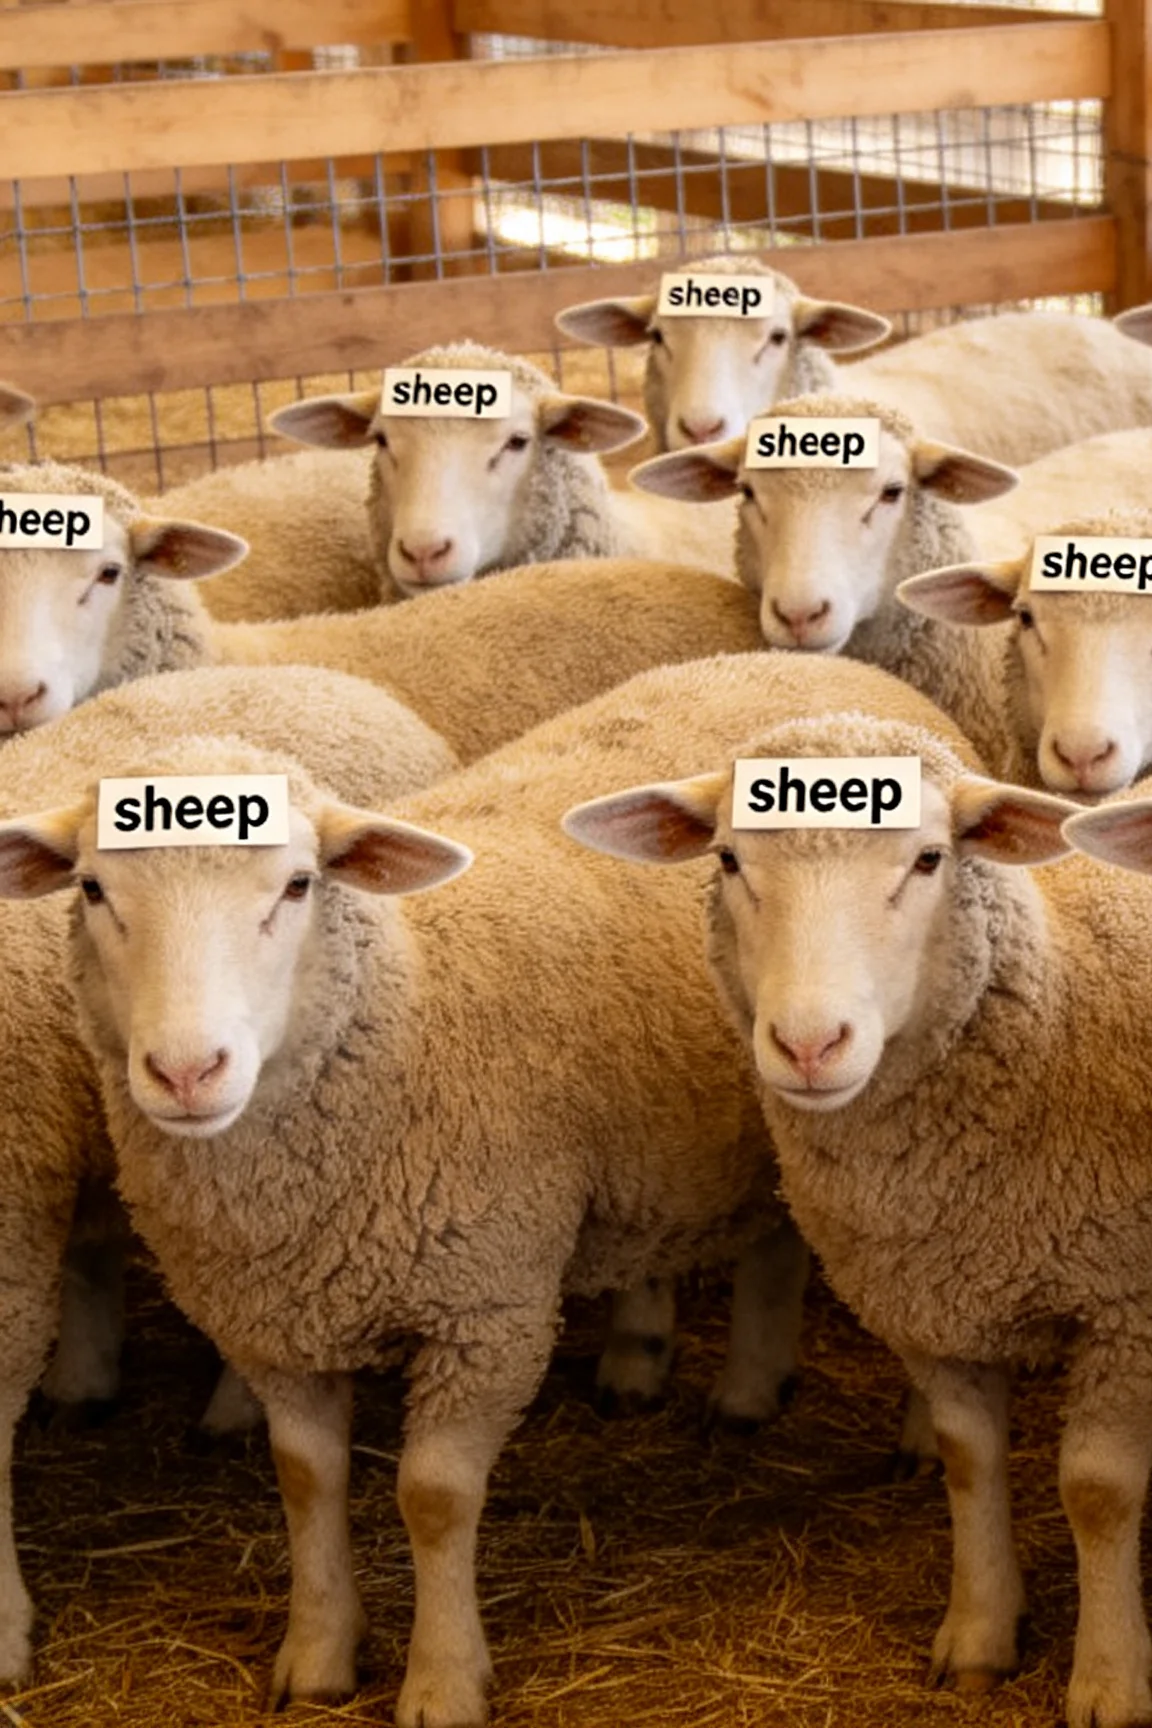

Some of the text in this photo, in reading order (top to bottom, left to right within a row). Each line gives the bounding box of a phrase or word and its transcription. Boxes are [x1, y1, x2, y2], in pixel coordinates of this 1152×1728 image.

[669, 279, 762, 316] sheep
[393, 373, 498, 415] sheep
[757, 423, 865, 465] sheep
[0, 499, 91, 546] heep
[114, 785, 269, 840] sheep
[748, 766, 902, 825] sheep
